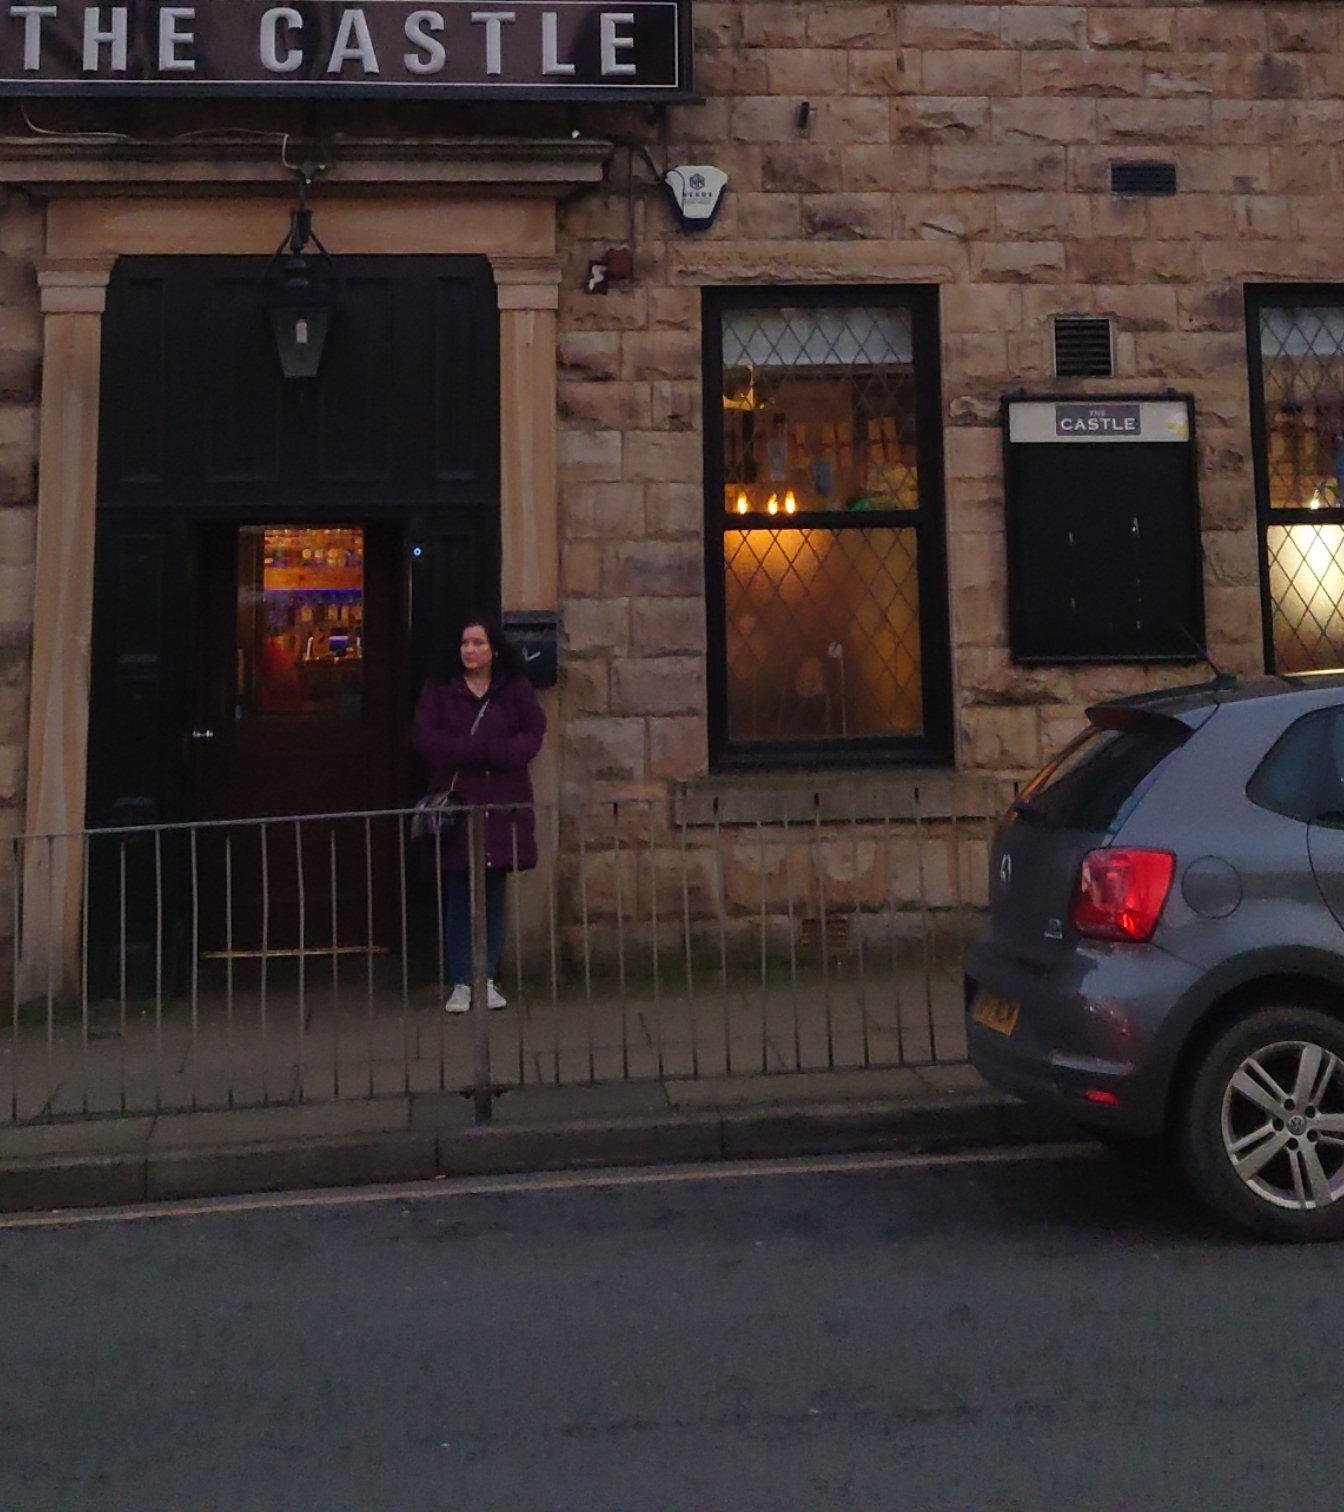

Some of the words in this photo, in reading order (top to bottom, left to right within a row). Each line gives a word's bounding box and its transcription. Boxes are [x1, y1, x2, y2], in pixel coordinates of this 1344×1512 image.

[10, 5, 196, 72] THE
[259, 6, 637, 76] CASTLE
[1060, 417, 1136, 431] CASTLE
